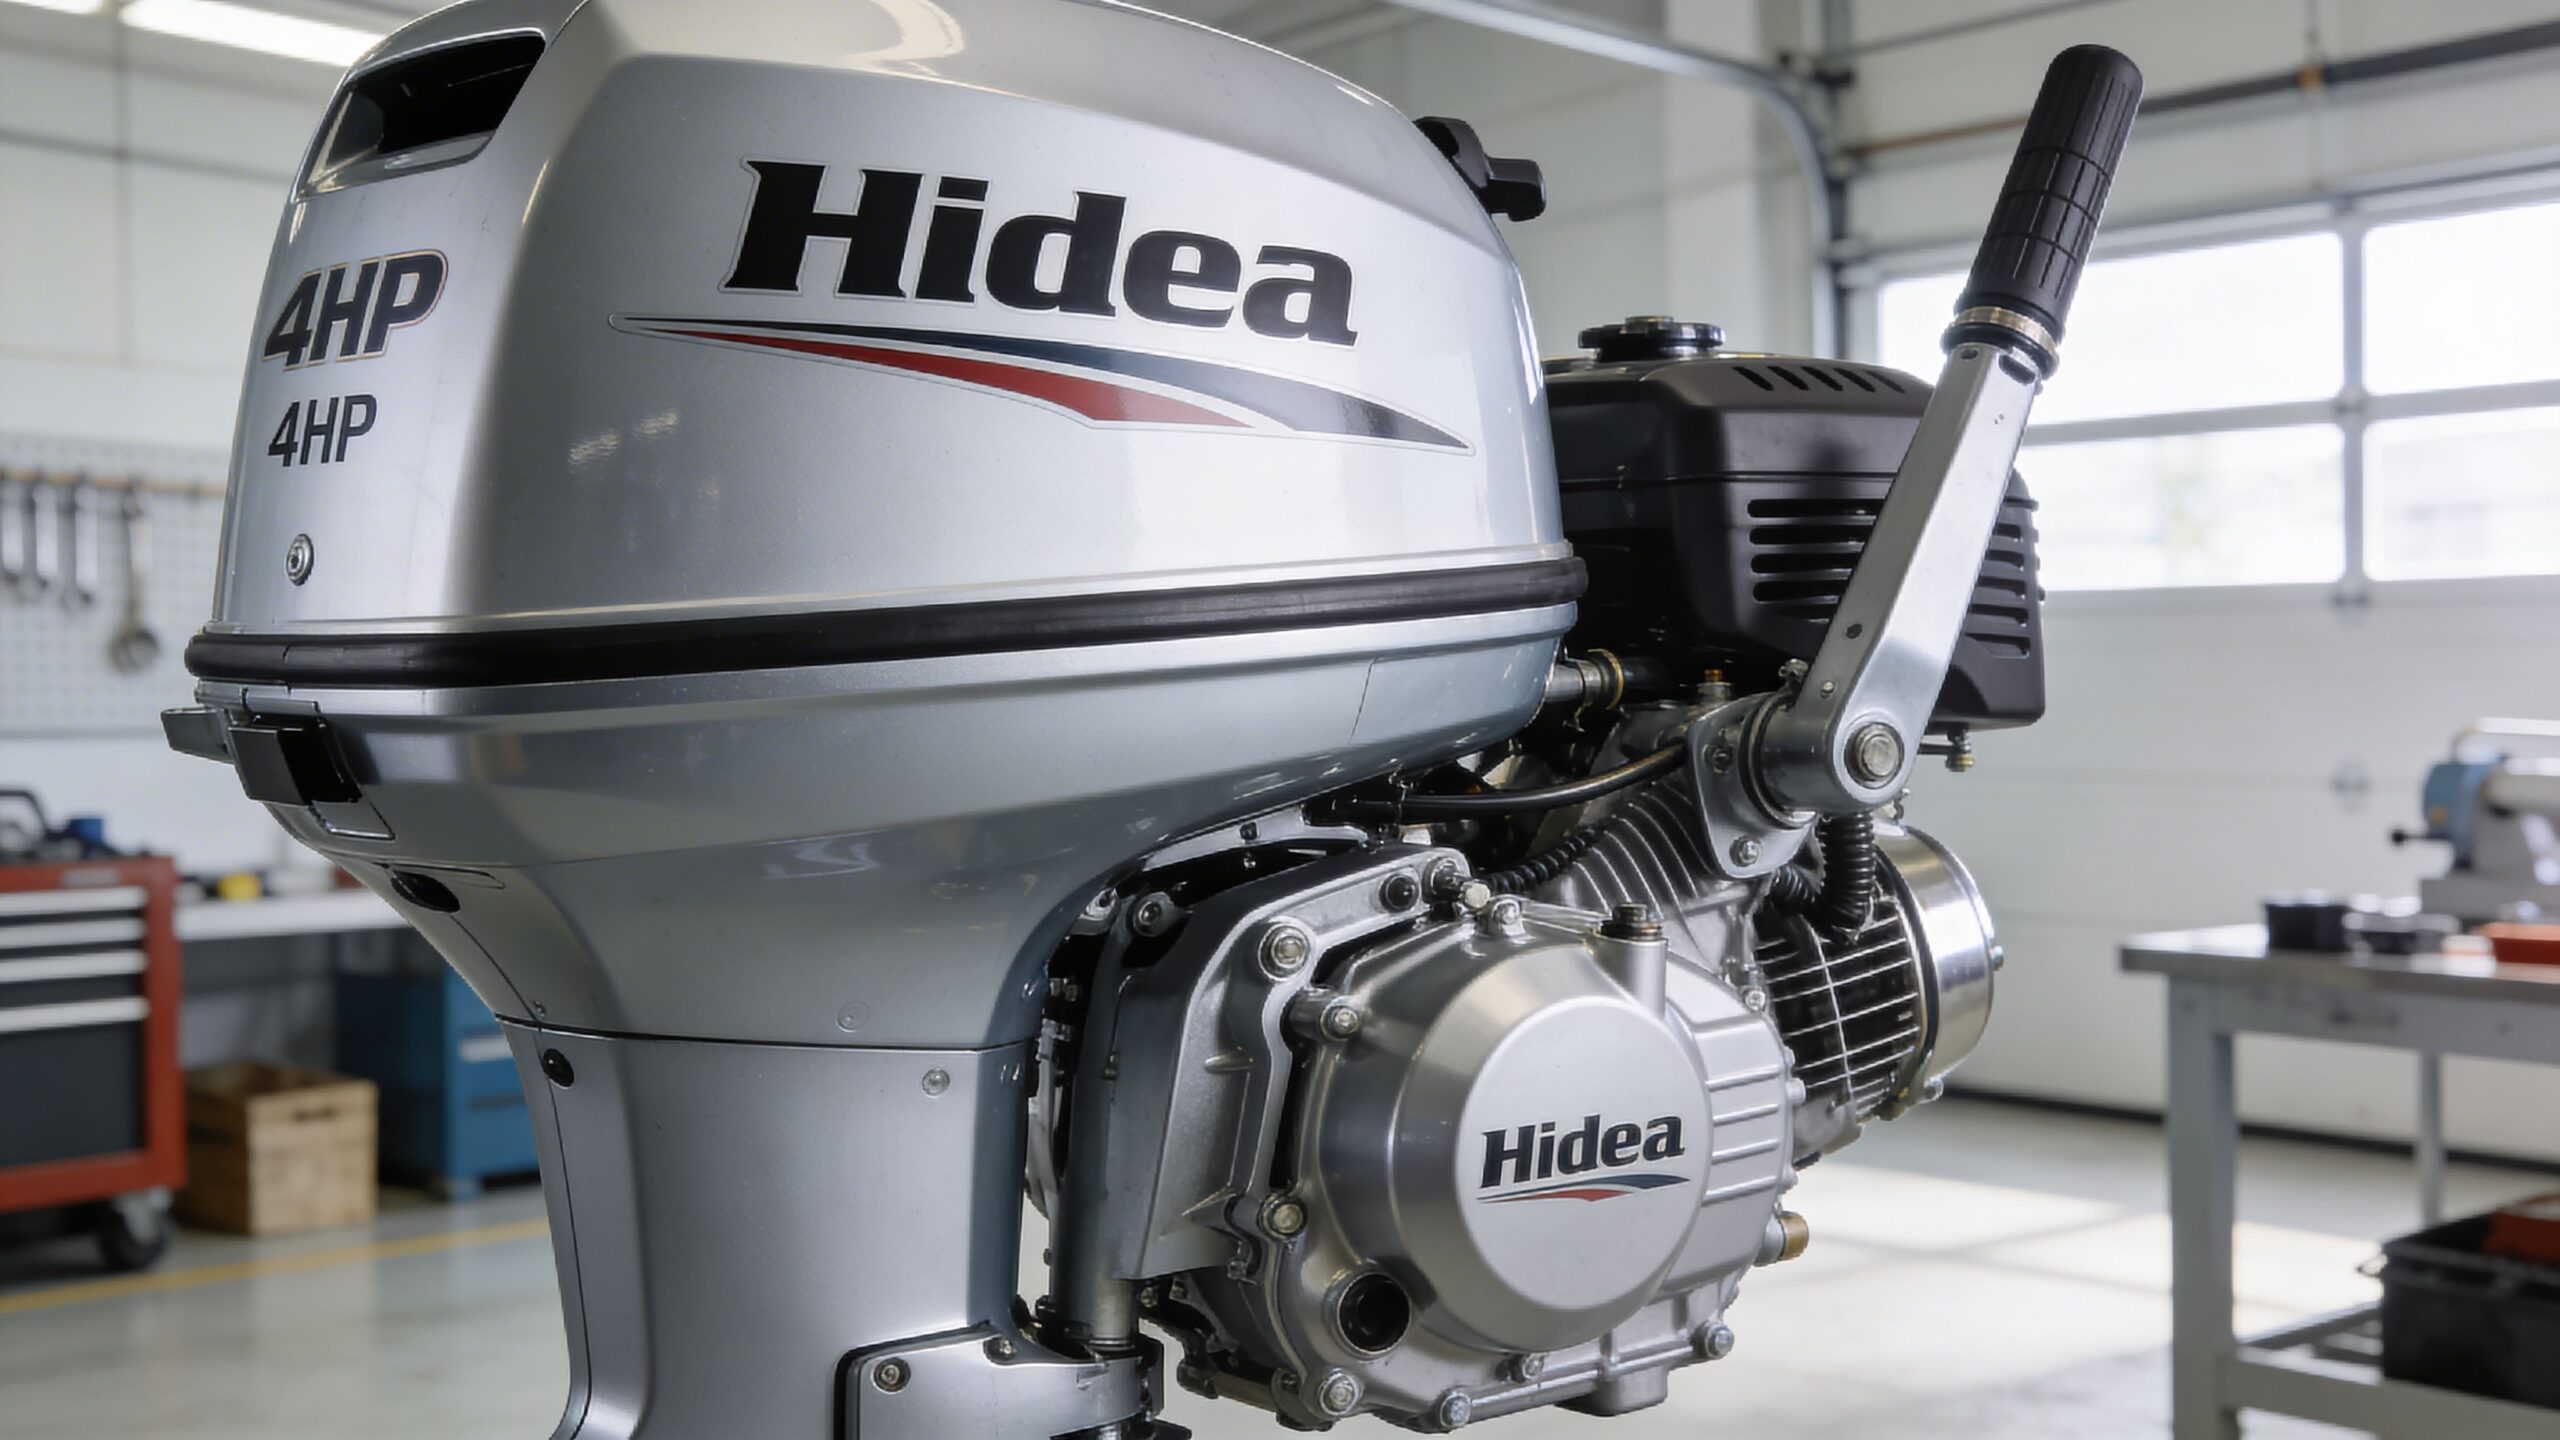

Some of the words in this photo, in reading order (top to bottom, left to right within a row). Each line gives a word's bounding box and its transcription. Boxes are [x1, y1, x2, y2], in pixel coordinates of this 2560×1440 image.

[725, 160, 1358, 346] Hidea
[264, 251, 446, 370] 4HP
[268, 394, 377, 467] 4HP
[1480, 1114, 1685, 1189] Hidea
